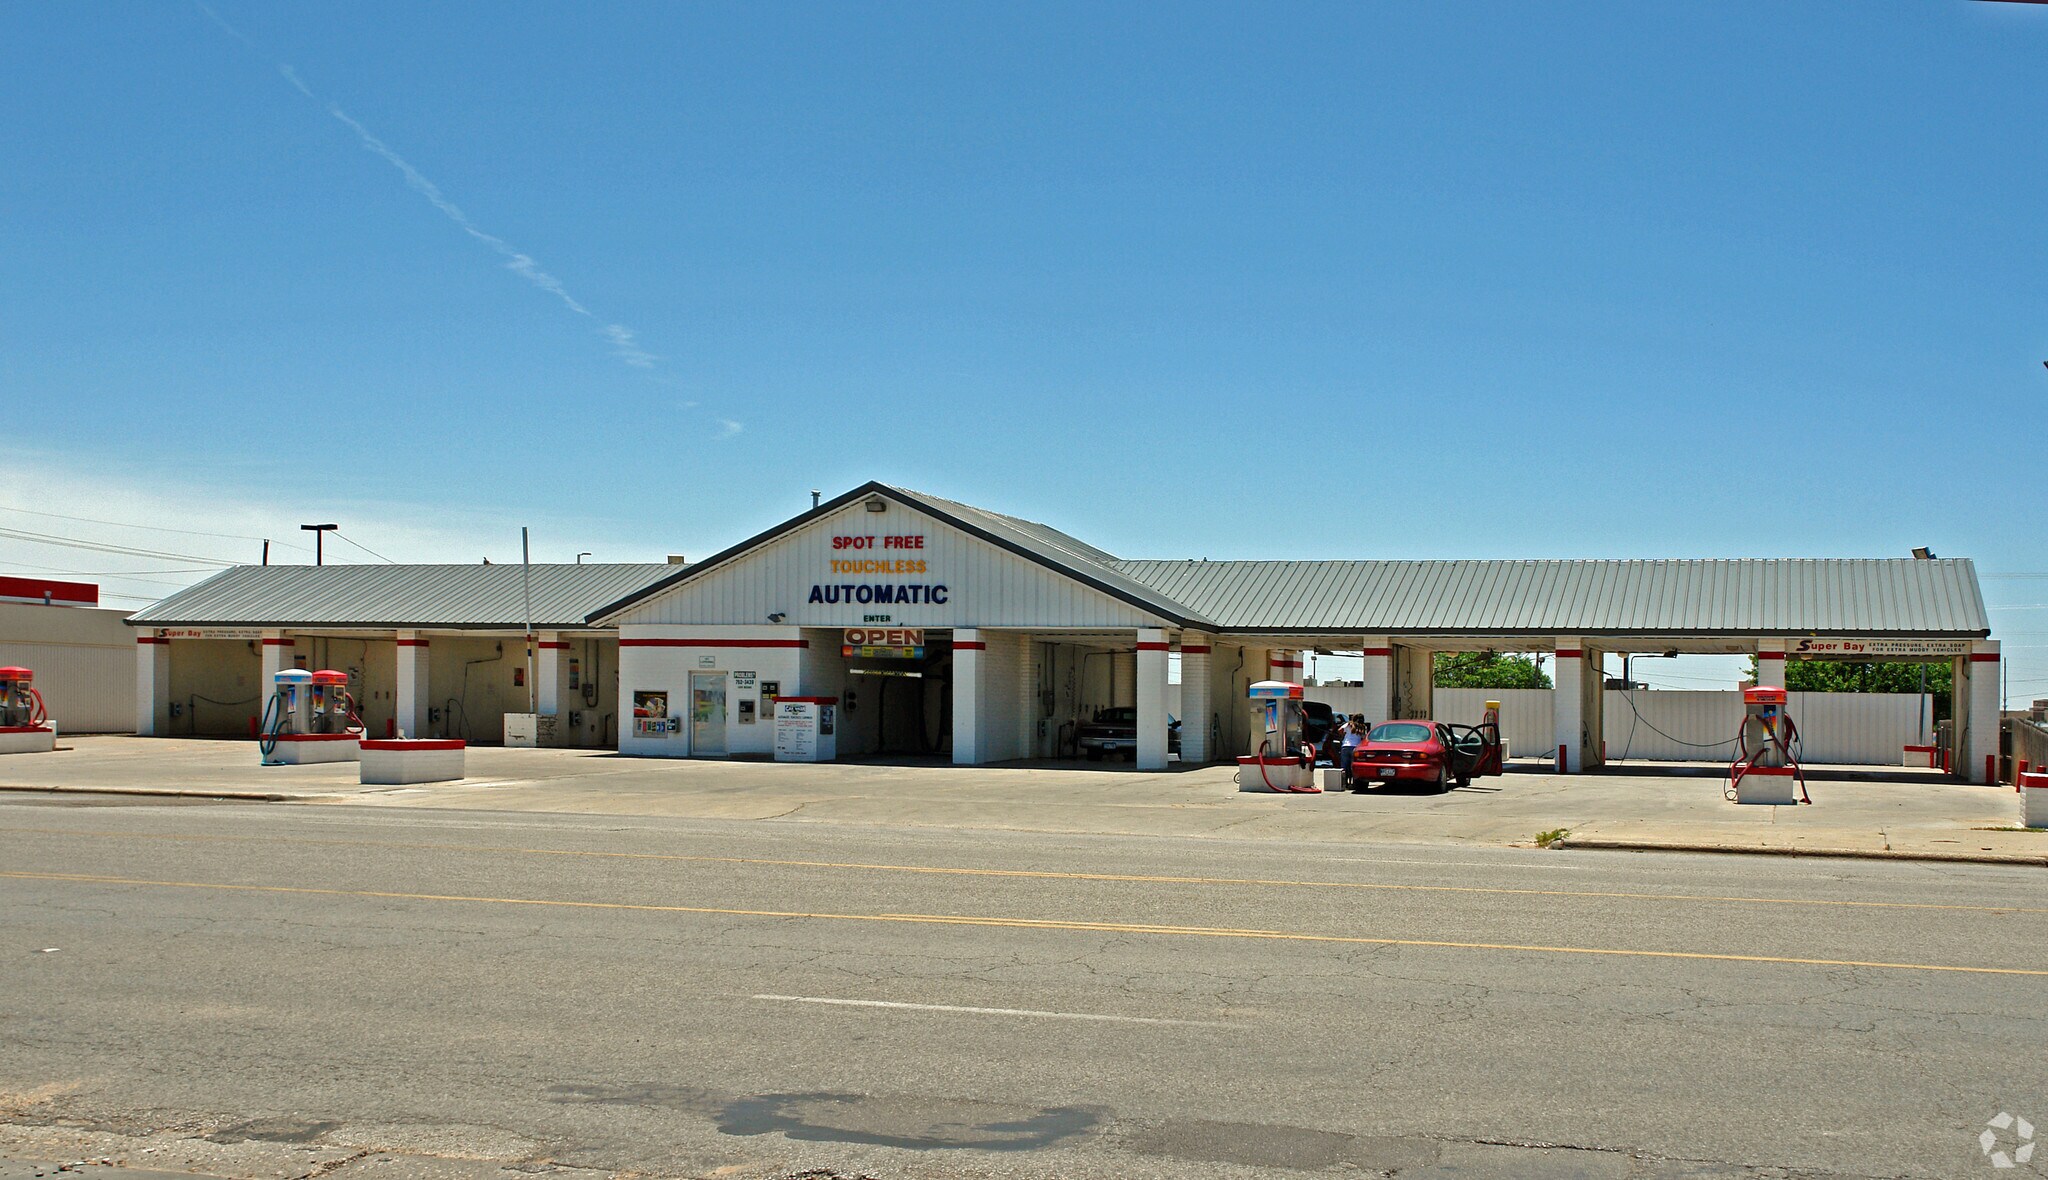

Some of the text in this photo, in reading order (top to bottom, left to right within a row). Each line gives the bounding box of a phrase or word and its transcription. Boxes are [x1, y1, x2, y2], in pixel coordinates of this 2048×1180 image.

[832, 536, 924, 549] SPOT FREE
[830, 560, 926, 574] TOUCHLESS
[808, 585, 948, 604] AUTOMATIC
[158, 628, 184, 637] Super
[846, 630, 922, 645] OPEN
[1796, 640, 1865, 652] Super Bay
